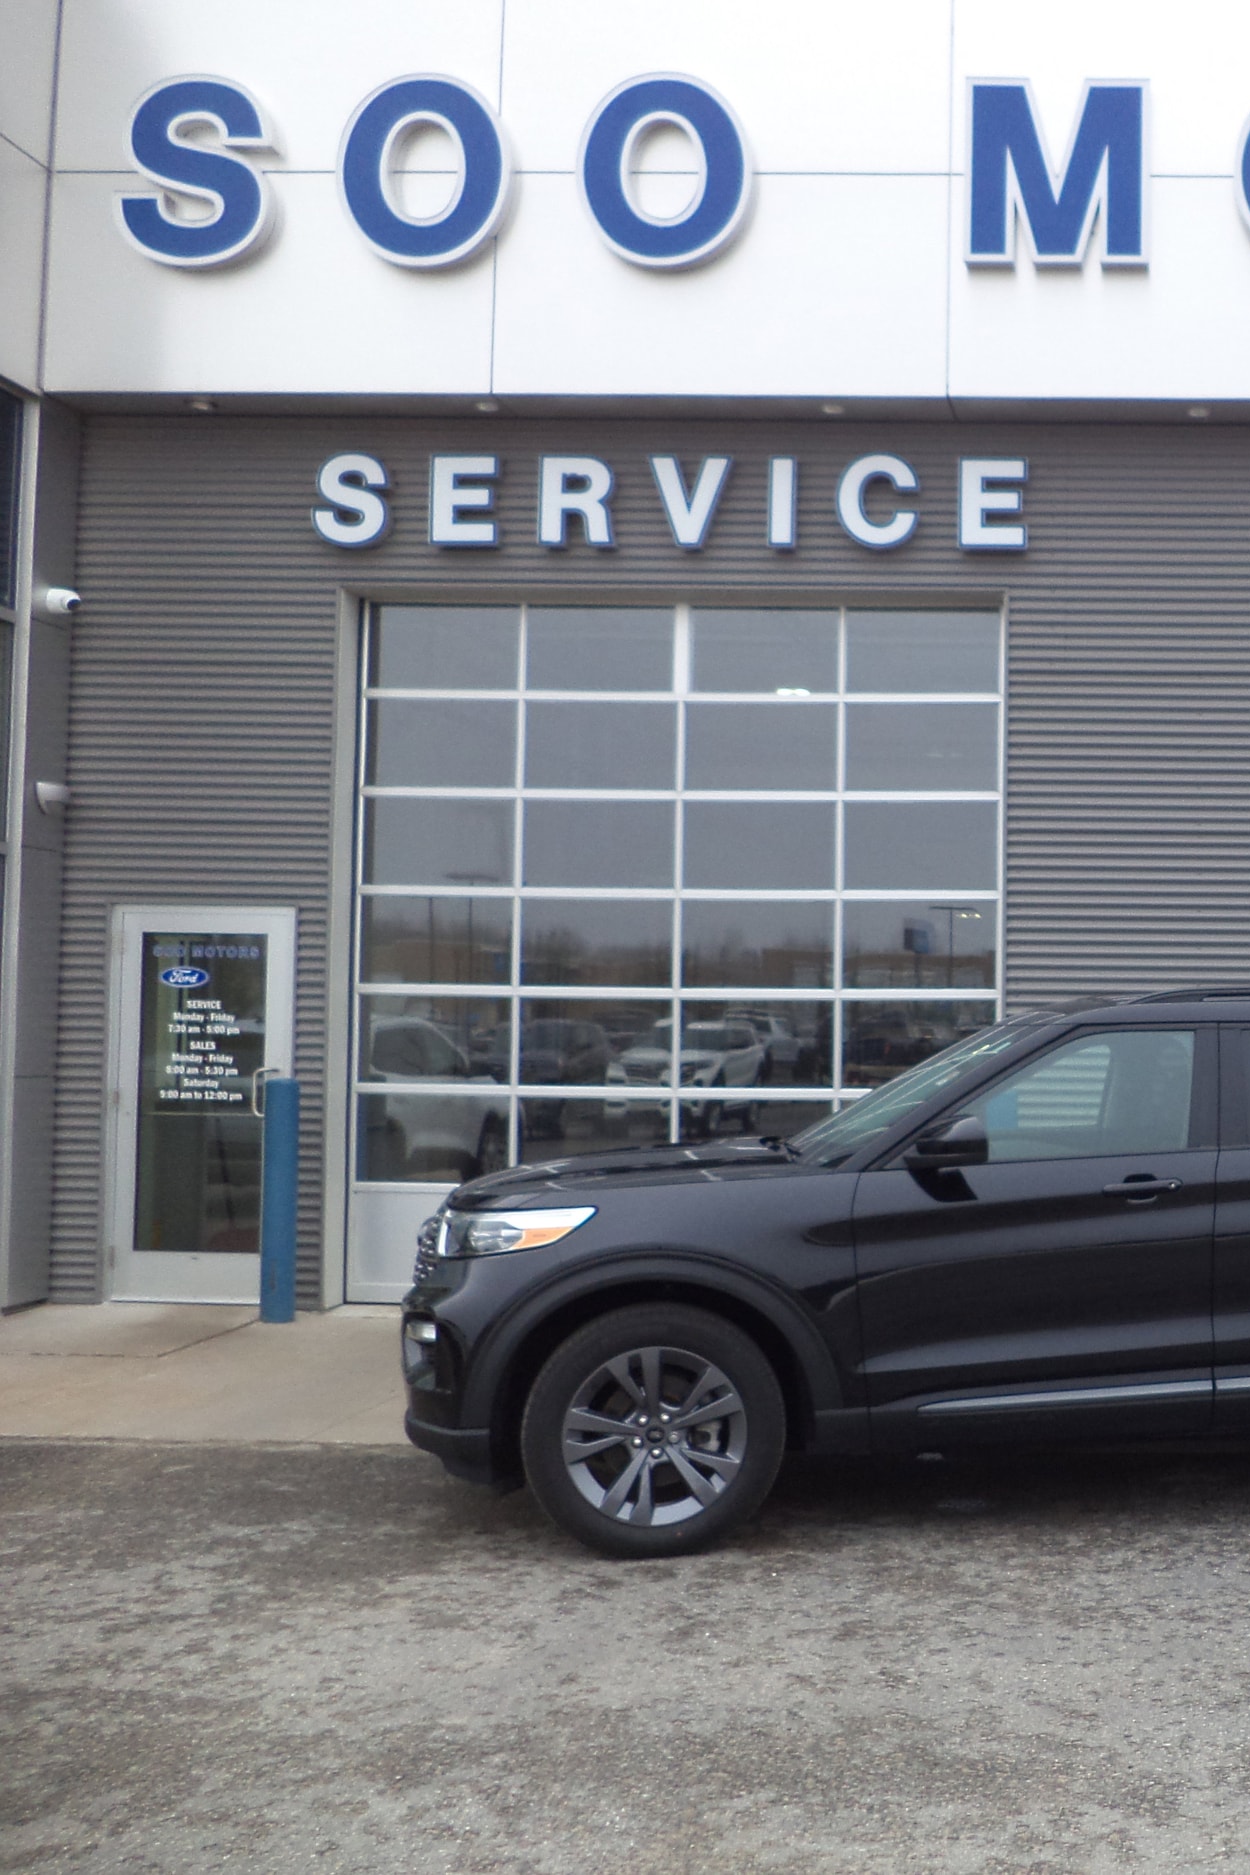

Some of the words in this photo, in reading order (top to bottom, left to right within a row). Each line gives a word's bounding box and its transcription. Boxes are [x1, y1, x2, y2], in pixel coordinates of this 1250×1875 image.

[115, 71, 757, 269] SOO
[311, 452, 1029, 551] SERVICE
[192, 945, 260, 959] MOTORS
[186, 1000, 222, 1009] SERVICE
[173, 1012, 204, 1023] Monday
[210, 1012, 235, 1023] Friday
[227, 1027, 240, 1036] pm
[190, 1041, 216, 1050] SALES
[172, 1053, 203, 1063] Monday
[209, 1054, 233, 1064] Friday
[225, 1068, 238, 1077] pm
[183, 1078, 219, 1089] Saturday
[194, 1091, 202, 1099] to
[204, 1091, 228, 1100] 12:00
[229, 1093, 243, 1101] pm
